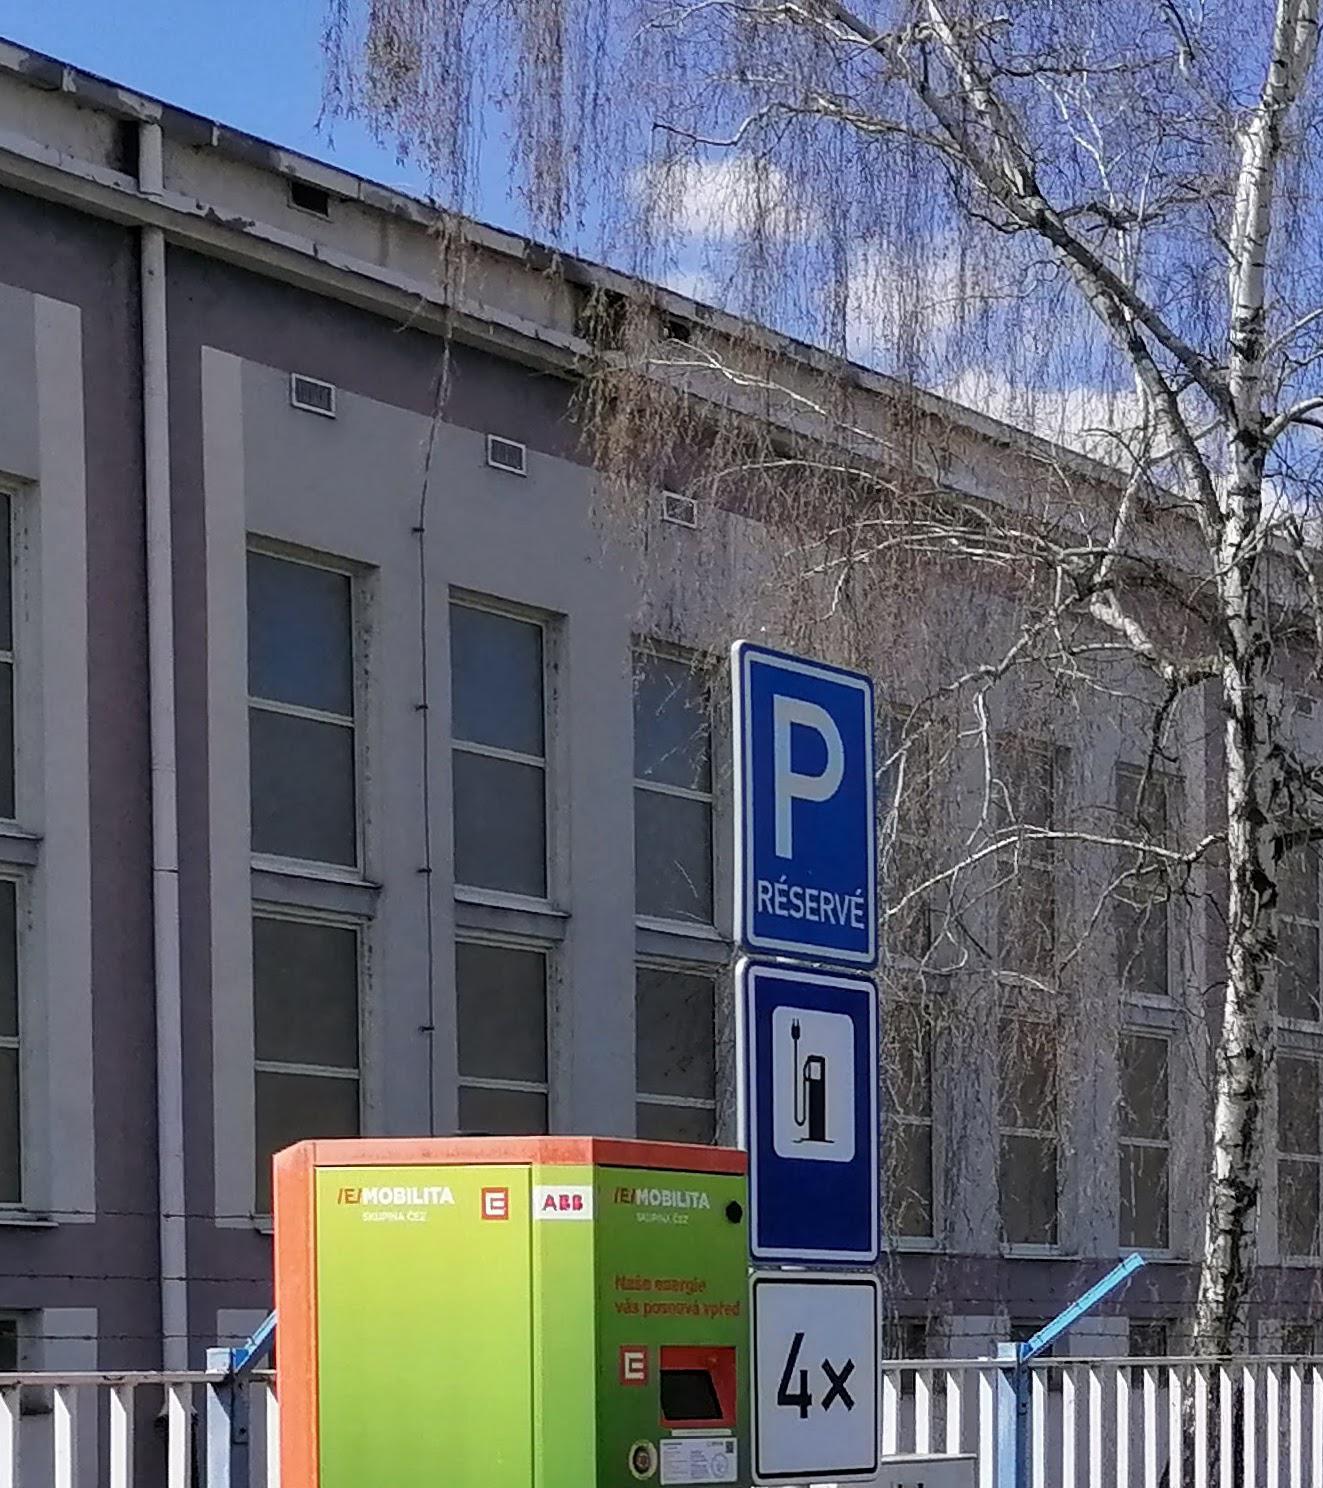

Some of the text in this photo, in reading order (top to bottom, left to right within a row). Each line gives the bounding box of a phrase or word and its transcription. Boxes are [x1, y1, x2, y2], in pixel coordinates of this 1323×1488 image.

[773, 694, 845, 859] P
[757, 876, 865, 929] RÉSERVÉ
[542, 1194, 583, 1211] ABB
[776, 1332, 855, 1420] 4x
